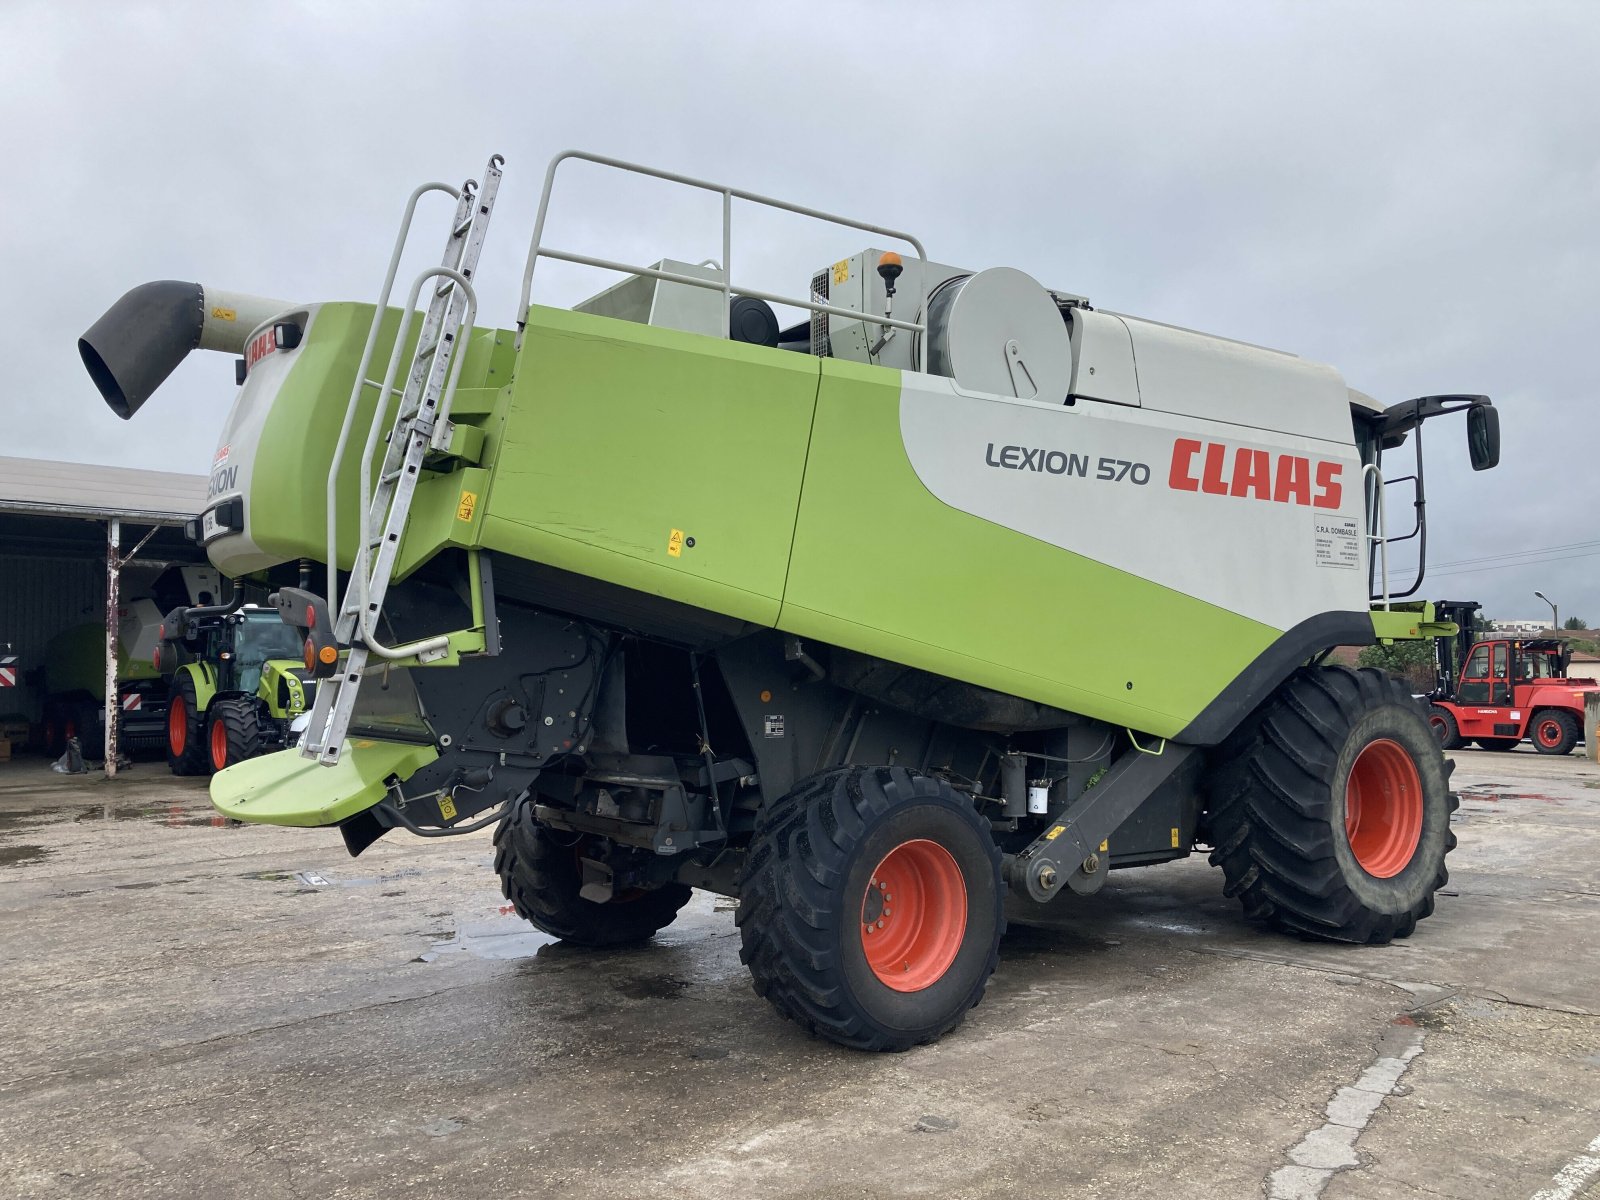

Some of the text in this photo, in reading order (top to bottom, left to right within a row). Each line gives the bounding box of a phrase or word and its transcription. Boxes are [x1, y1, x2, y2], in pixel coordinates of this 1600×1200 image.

[246, 330, 276, 369] LAAS
[985, 443, 1151, 486] LEXION 570
[1168, 437, 1343, 510] CLAAS
